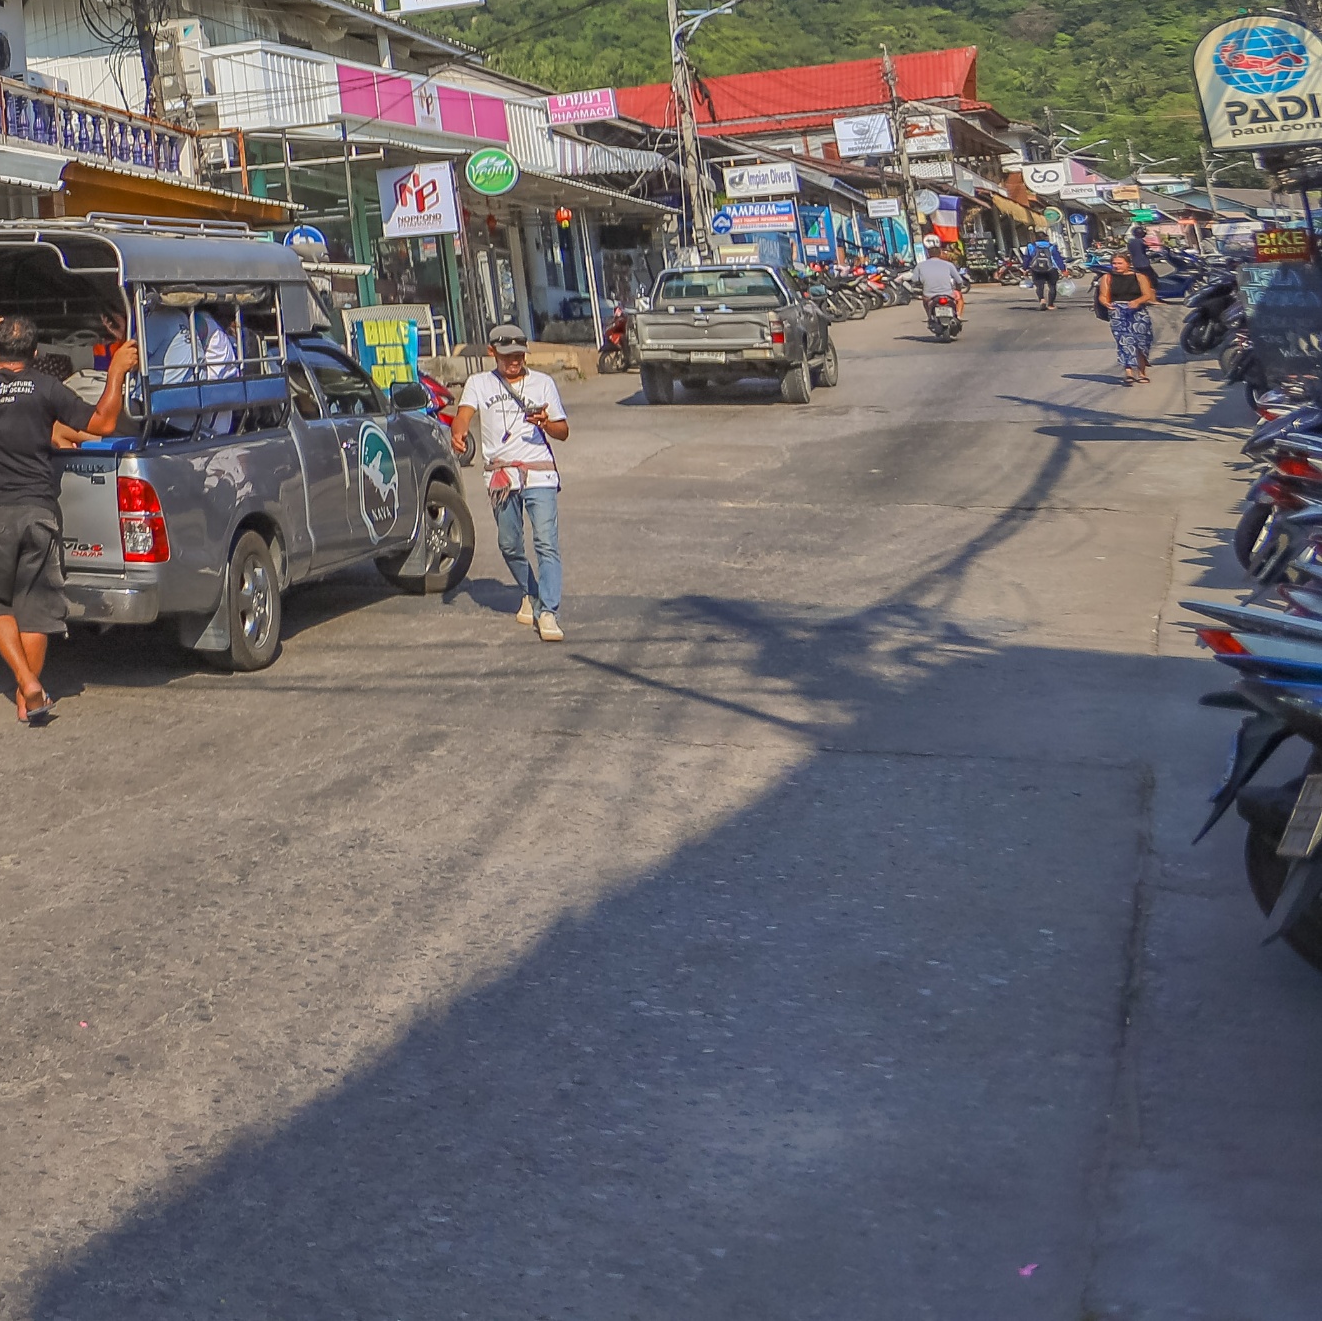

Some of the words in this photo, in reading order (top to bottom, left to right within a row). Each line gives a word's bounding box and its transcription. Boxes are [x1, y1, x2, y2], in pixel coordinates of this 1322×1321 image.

[551, 106, 610, 123] PHARMACY
[1224, 93, 1322, 126] PADI
[1231, 121, 1322, 138] padi.com
[769, 168, 792, 184] Divers
[397, 213, 442, 224] NOPPOND
[1258, 247, 1278, 255] FOR
[1280, 246, 1305, 254] RENT
[63, 543, 104, 552] VIGO
[70, 550, 103, 558] CHAMP
